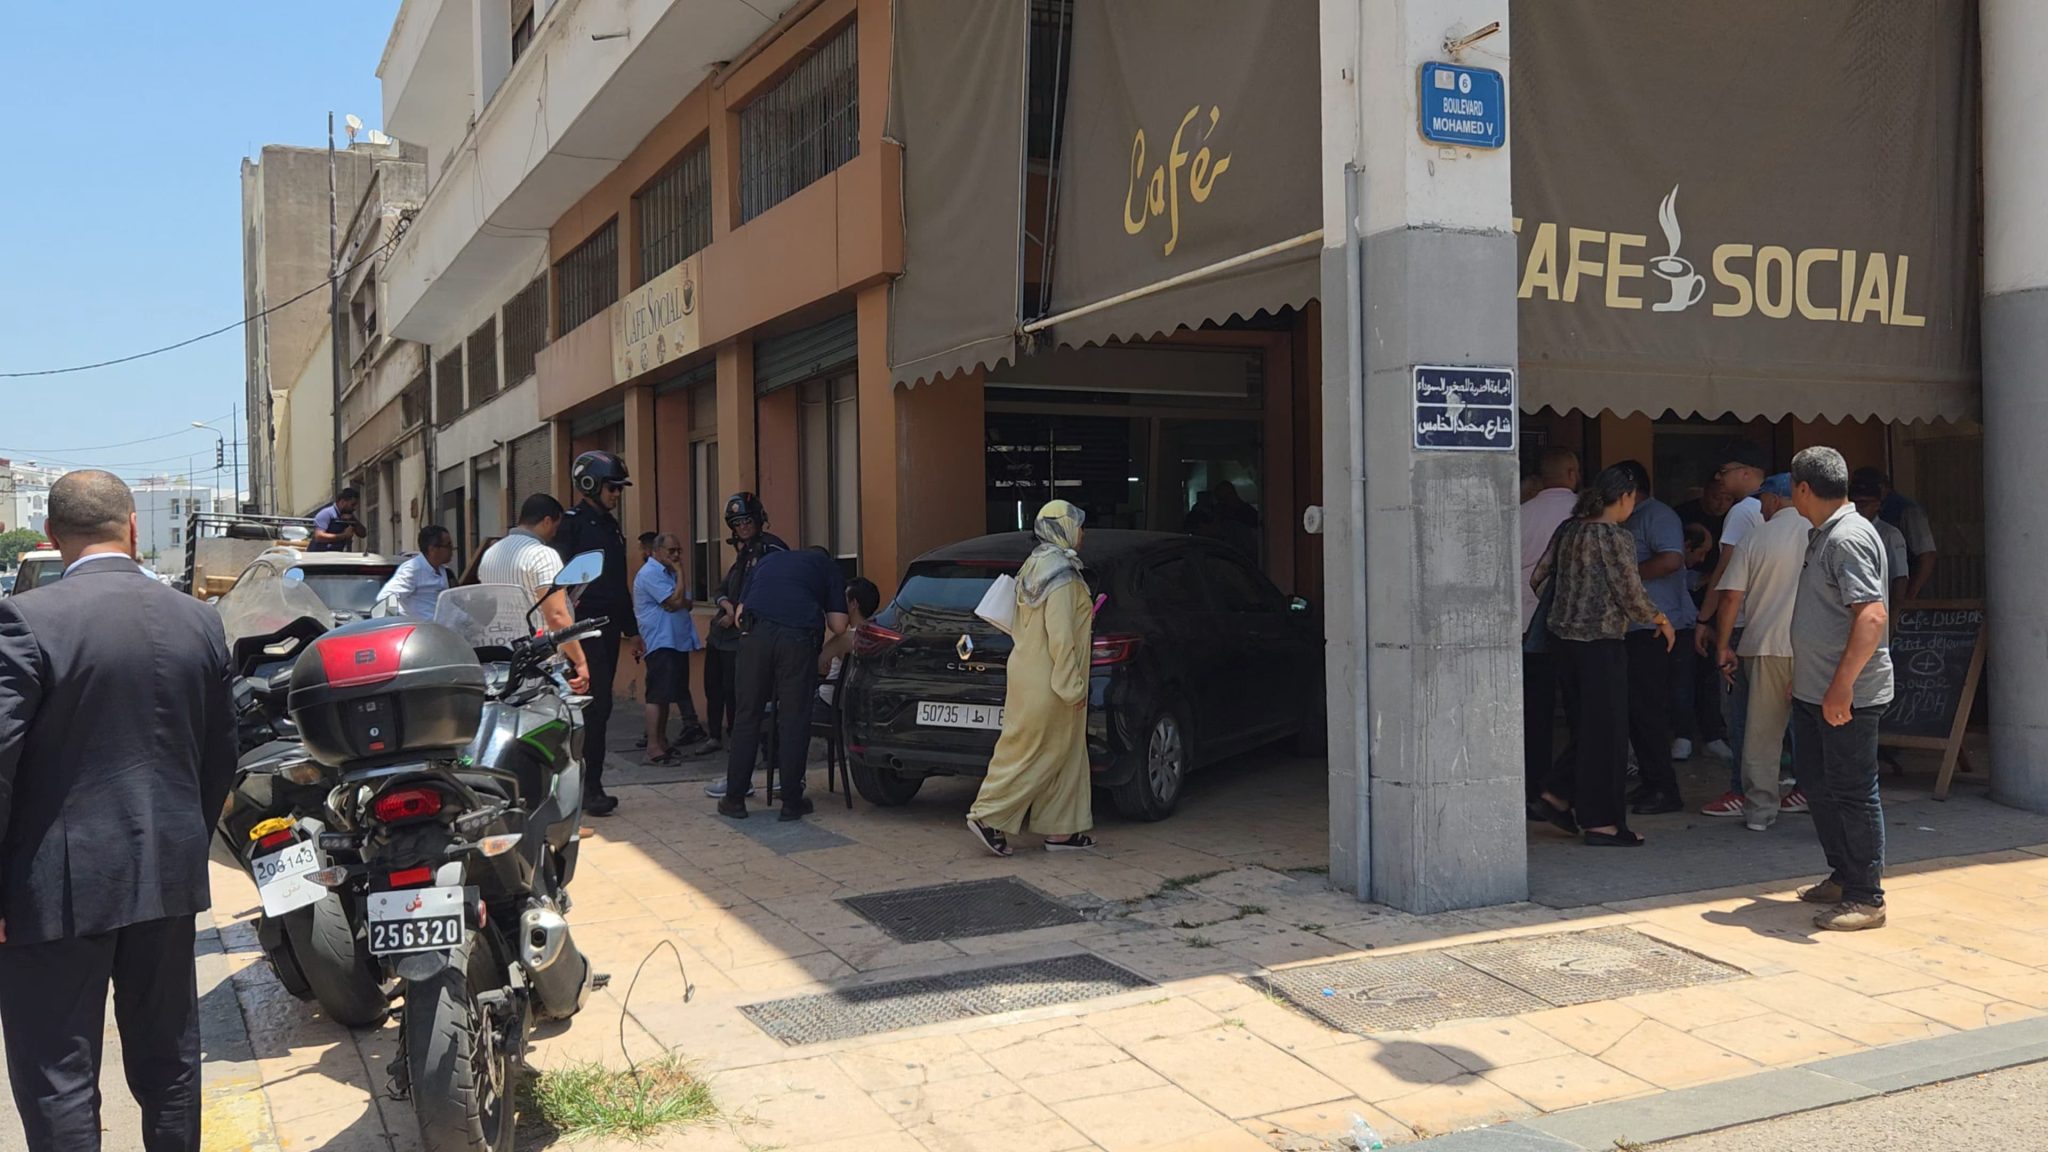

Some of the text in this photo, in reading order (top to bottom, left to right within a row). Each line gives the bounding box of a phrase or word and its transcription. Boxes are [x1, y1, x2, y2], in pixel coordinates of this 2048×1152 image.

[1461, 78, 1469, 89] 6
[1443, 97, 1484, 117] BOULEVARD
[1433, 117, 1494, 136] MOHAMED V
[1124, 104, 1232, 257] Café
[1512, 217, 1926, 327] AFE SOCIAL
[1417, 413, 1511, 440] شارع محمد الخامس
[922, 704, 959, 723] 50735
[374, 918, 458, 949] 256320
